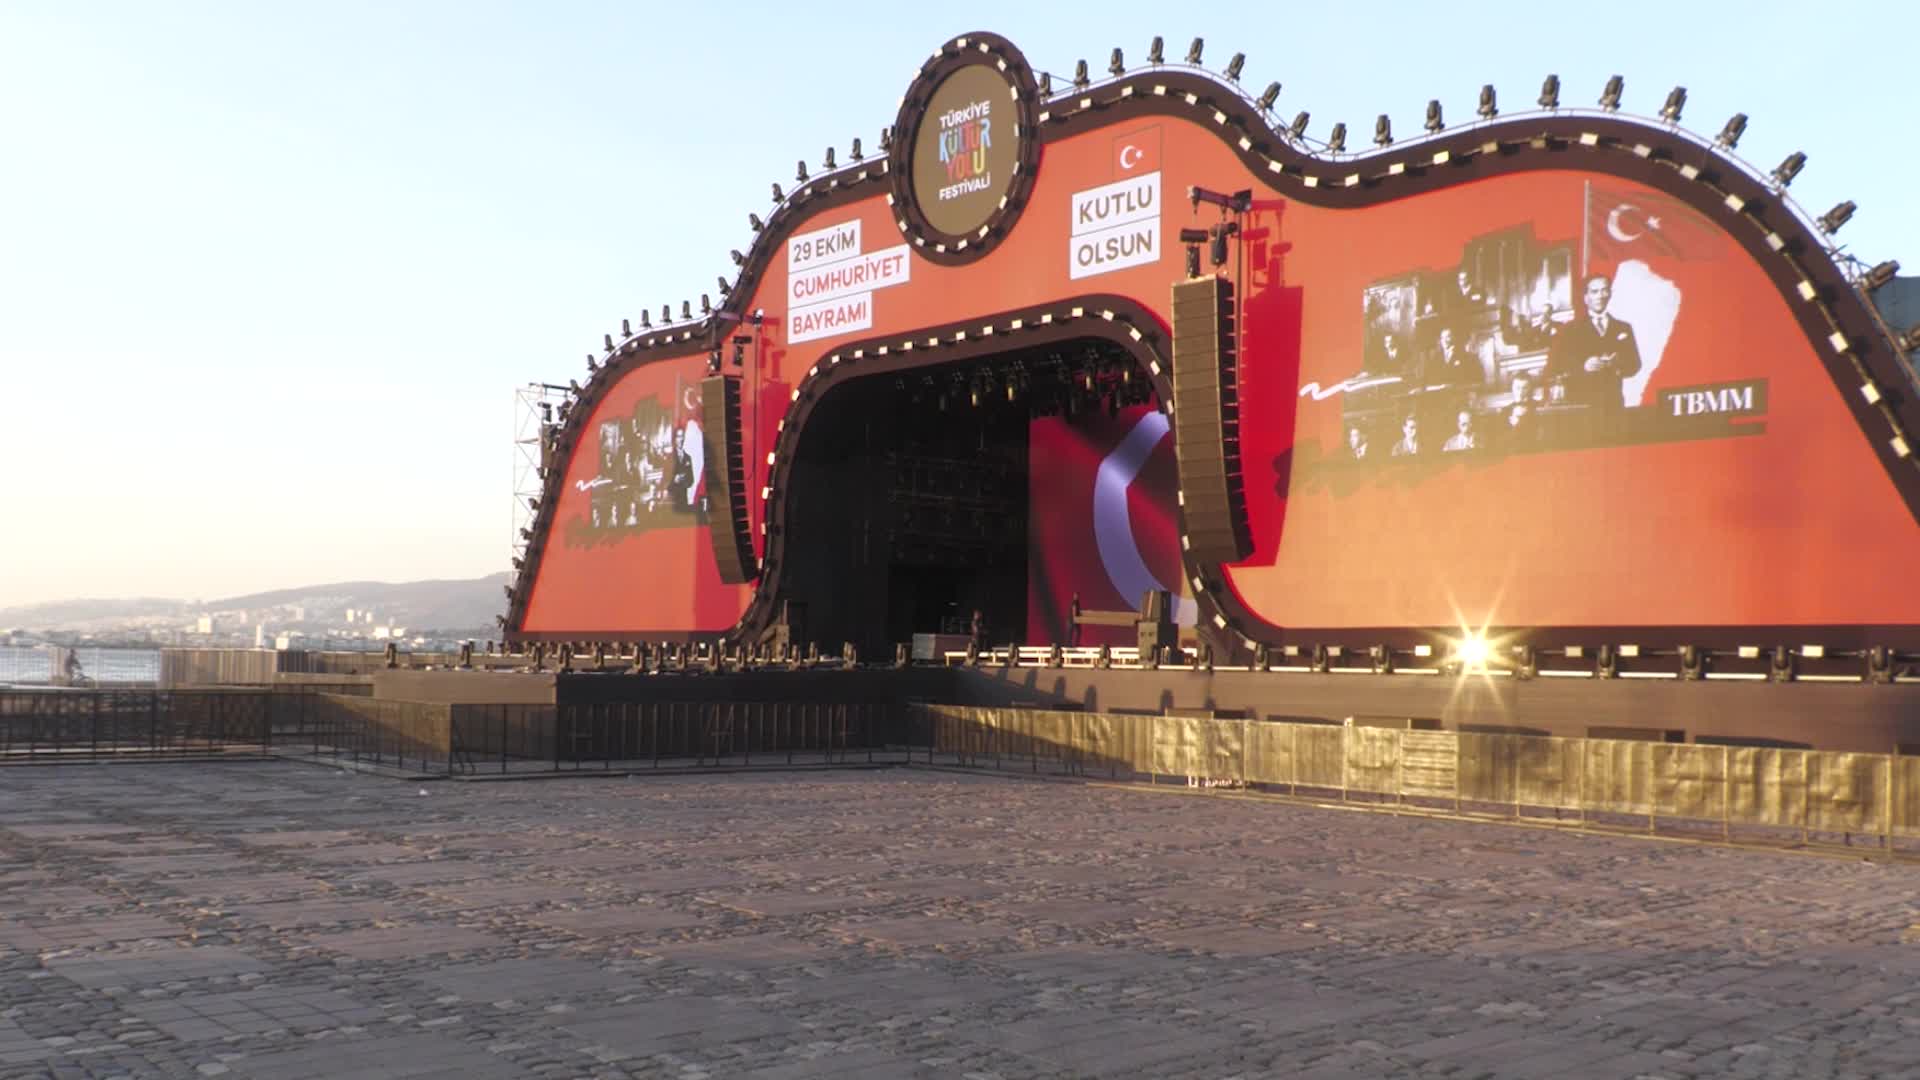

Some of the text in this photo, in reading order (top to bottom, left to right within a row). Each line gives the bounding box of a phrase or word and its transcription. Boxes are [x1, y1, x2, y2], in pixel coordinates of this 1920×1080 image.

[940, 100, 991, 128] TÜRKİYE
[946, 146, 986, 188] YOLU
[939, 172, 992, 200] FESTİVALİ
[1079, 185, 1153, 224] KUTLU
[793, 228, 856, 263] 29 EKİM
[1077, 229, 1153, 267] OLSUN
[793, 254, 905, 299] CUMHURİYET
[792, 301, 867, 335] BAYRAMI
[1667, 386, 1754, 416] TBMM
